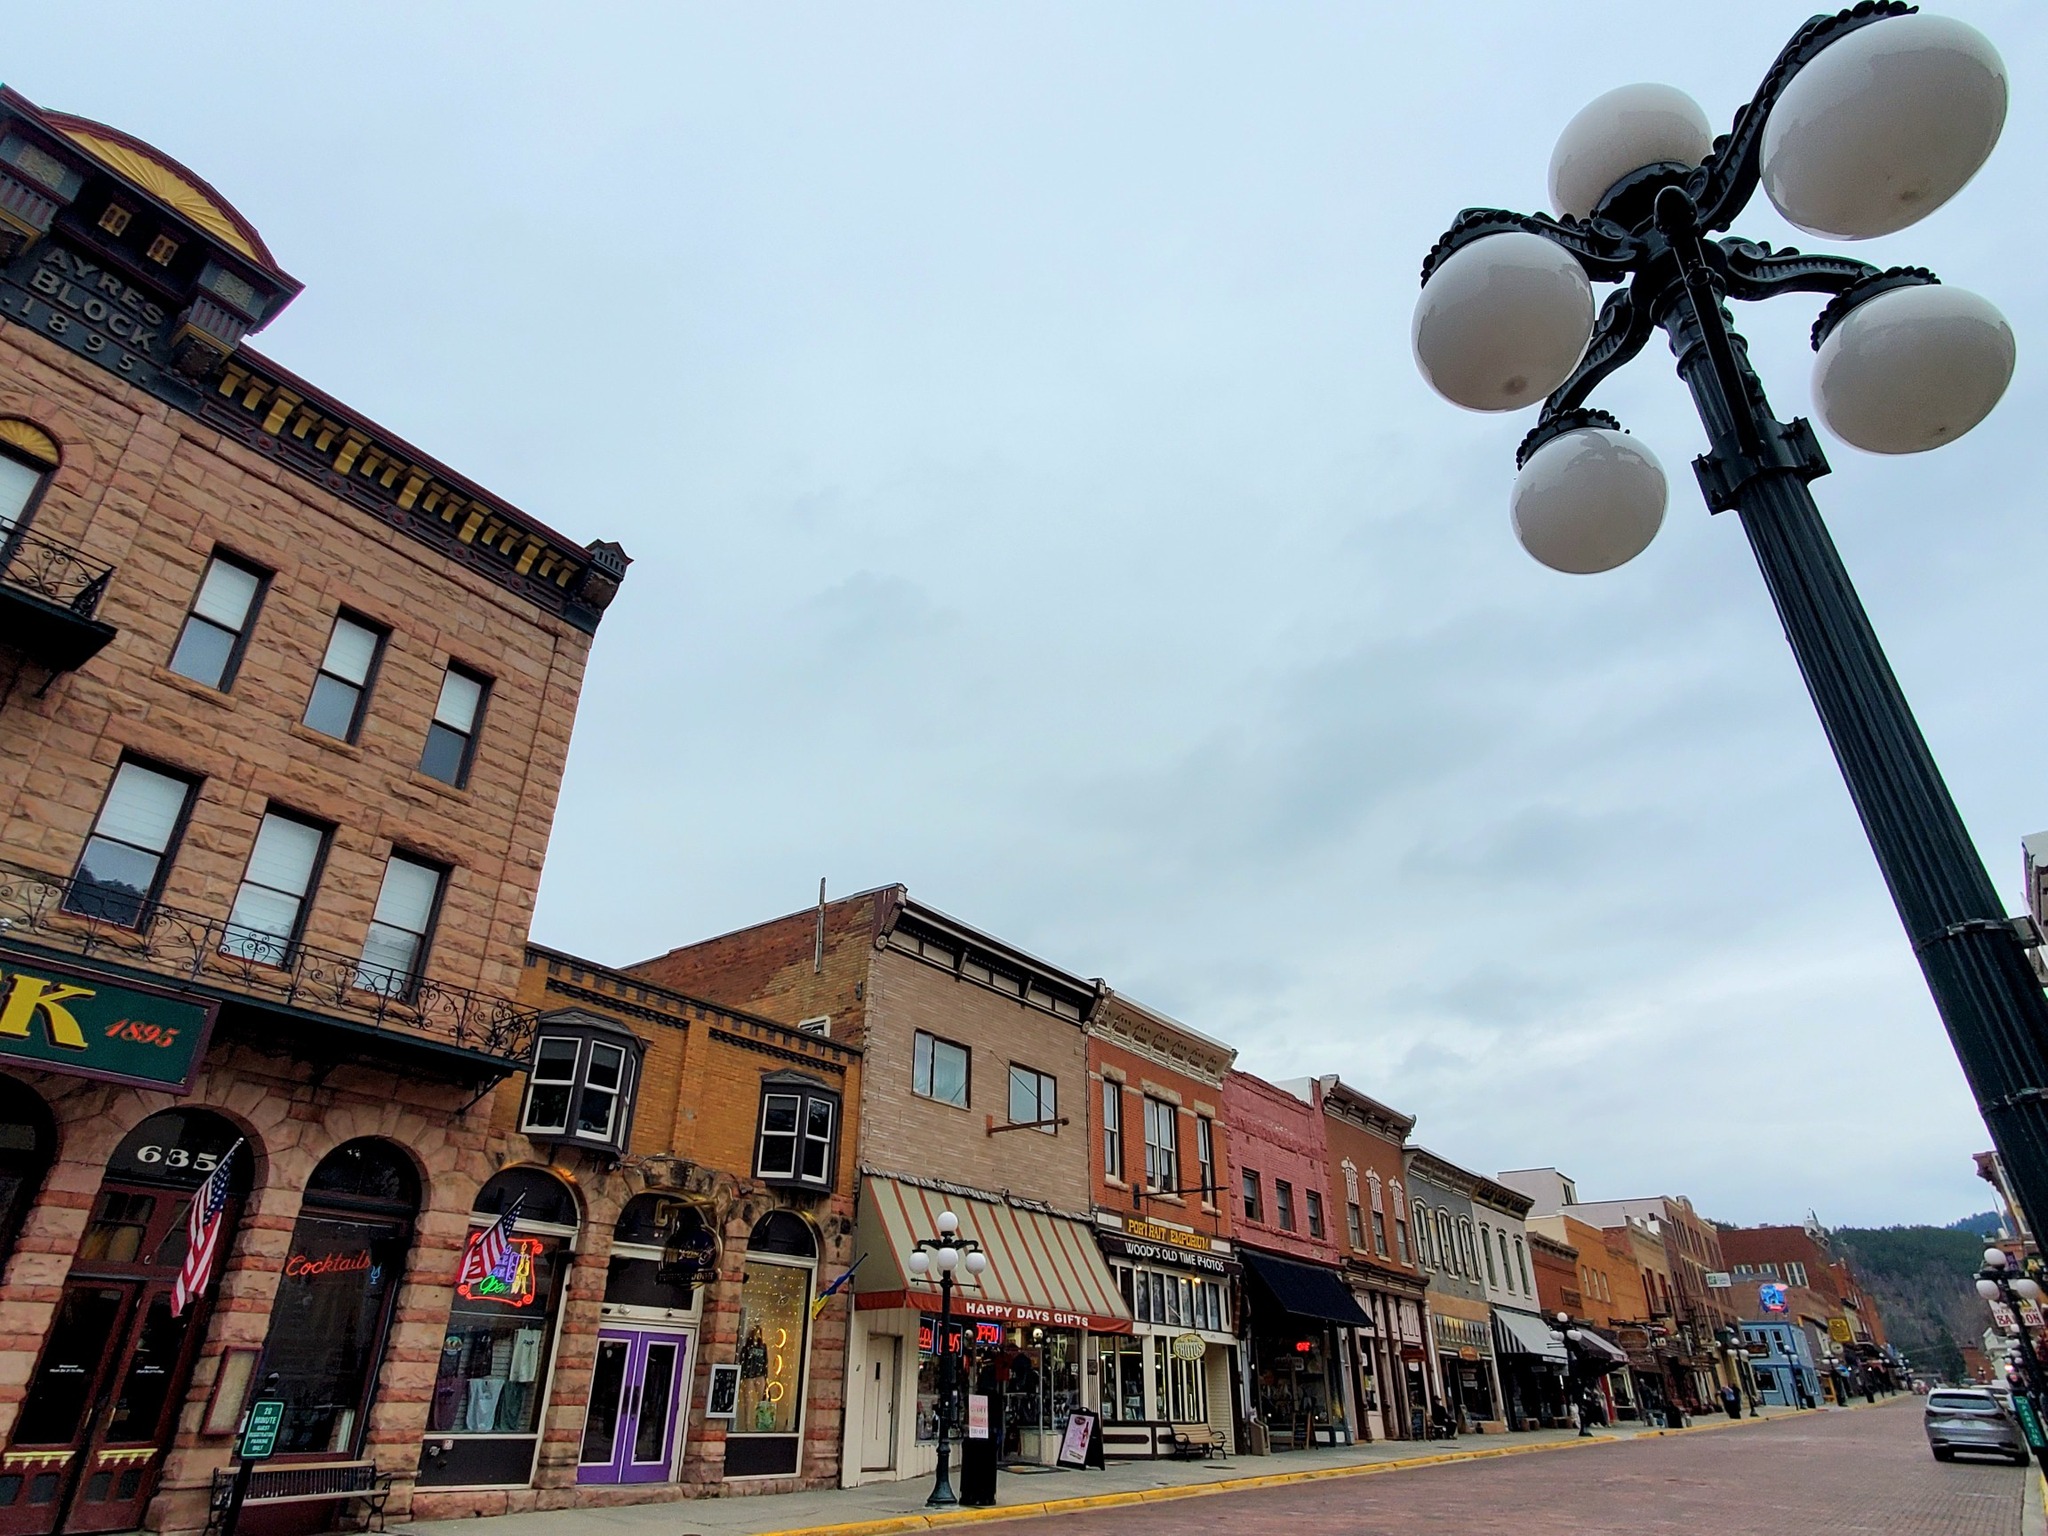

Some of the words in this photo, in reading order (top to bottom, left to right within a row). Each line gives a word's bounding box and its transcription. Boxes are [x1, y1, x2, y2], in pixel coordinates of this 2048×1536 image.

[42, 247, 165, 326] AYRES
[29, 267, 159, 352] BLOCK
[0, 969, 97, 1049] K
[104, 1018, 181, 1048] 1895
[136, 1145, 218, 1172] 635
[1128, 1218, 1167, 1241] PORTRAIT
[1170, 1229, 1210, 1250] EMPORIUM
[286, 1249, 372, 1276] Cocktails
[1125, 1242, 1161, 1258] WOOD'S
[1162, 1249, 1178, 1262] OLD
[1179, 1252, 1196, 1266] TIME
[1197, 1255, 1225, 1272] PHOTOS
[966, 1302, 1012, 1318] HAPPY
[1016, 1308, 1050, 1322] DAYS
[1054, 1313, 1089, 1327] GIFTS
